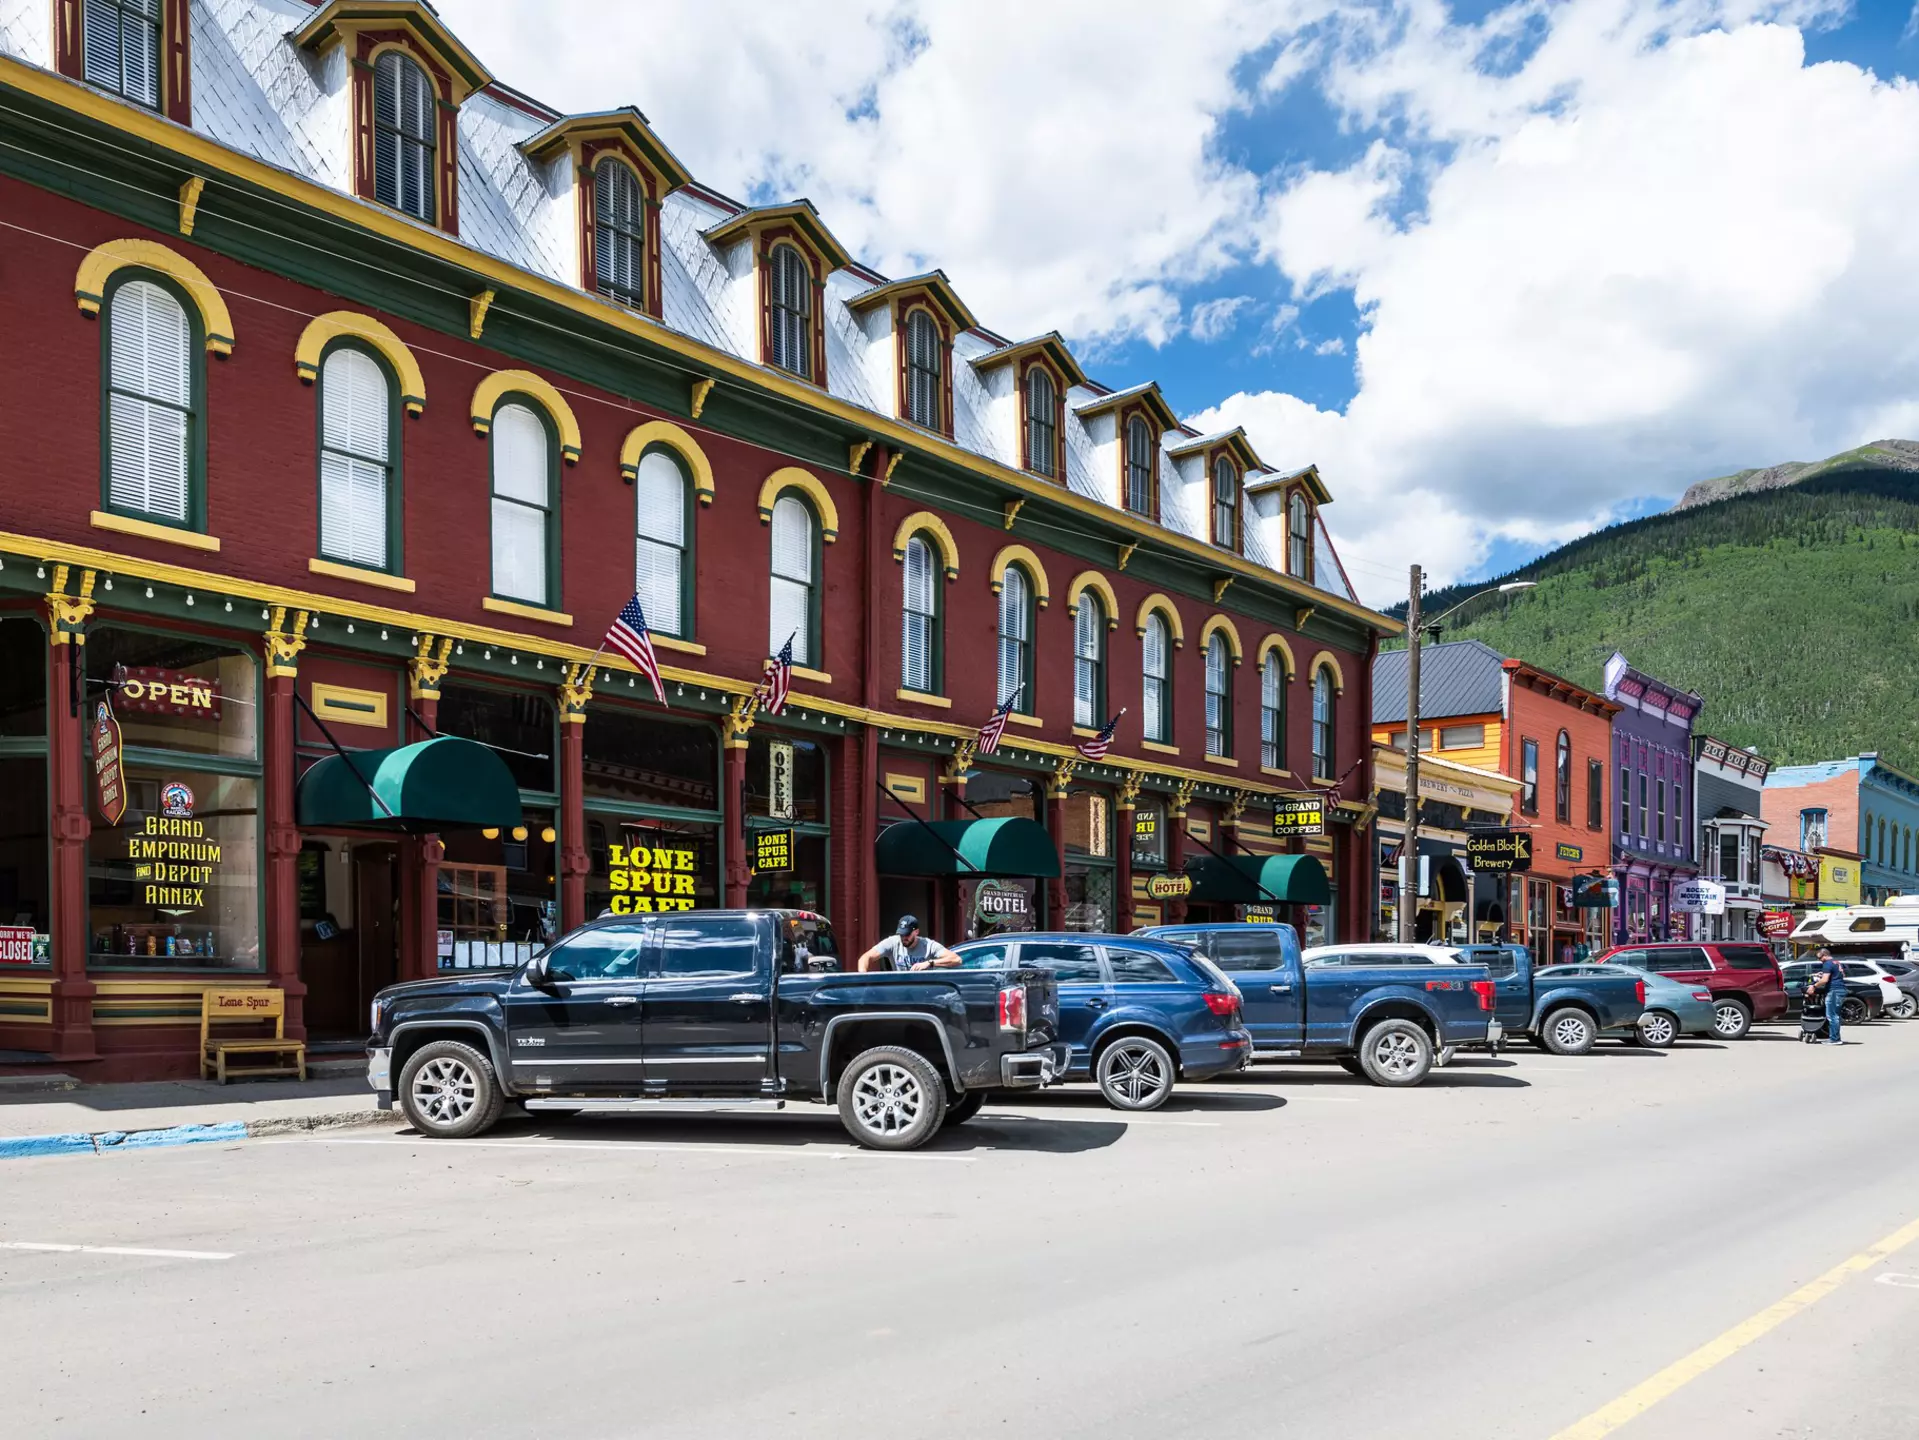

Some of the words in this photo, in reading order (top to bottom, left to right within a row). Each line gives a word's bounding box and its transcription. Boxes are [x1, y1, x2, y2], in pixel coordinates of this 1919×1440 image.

[124, 679, 212, 709] OPEN
[774, 751, 786, 812] OPEN
[1285, 801, 1320, 812] GRAND
[1275, 812, 1322, 826] SPUR
[146, 816, 203, 838] GRAND
[1275, 826, 1321, 834] COFFEE
[758, 834, 787, 846] LONE
[1467, 839, 1495, 852] Golden
[129, 838, 221, 863] EMPORIUM
[609, 844, 694, 871] LONE
[758, 845, 788, 857] SPUR
[758, 857, 787, 868] CAFE
[1474, 856, 1513, 869] Brewery
[136, 865, 151, 878] AND
[155, 862, 212, 884] DEPOT
[609, 869, 695, 895] SPUR
[1155, 883, 1188, 894] HOTEL
[145, 884, 204, 907] ANNEX
[983, 896, 1028, 913] HOTEL
[1252, 905, 1273, 915] GRAND
[0, 930, 14, 939] ORRY
[218, 995, 243, 1007] Lone
[246, 996, 270, 1010] Spur
